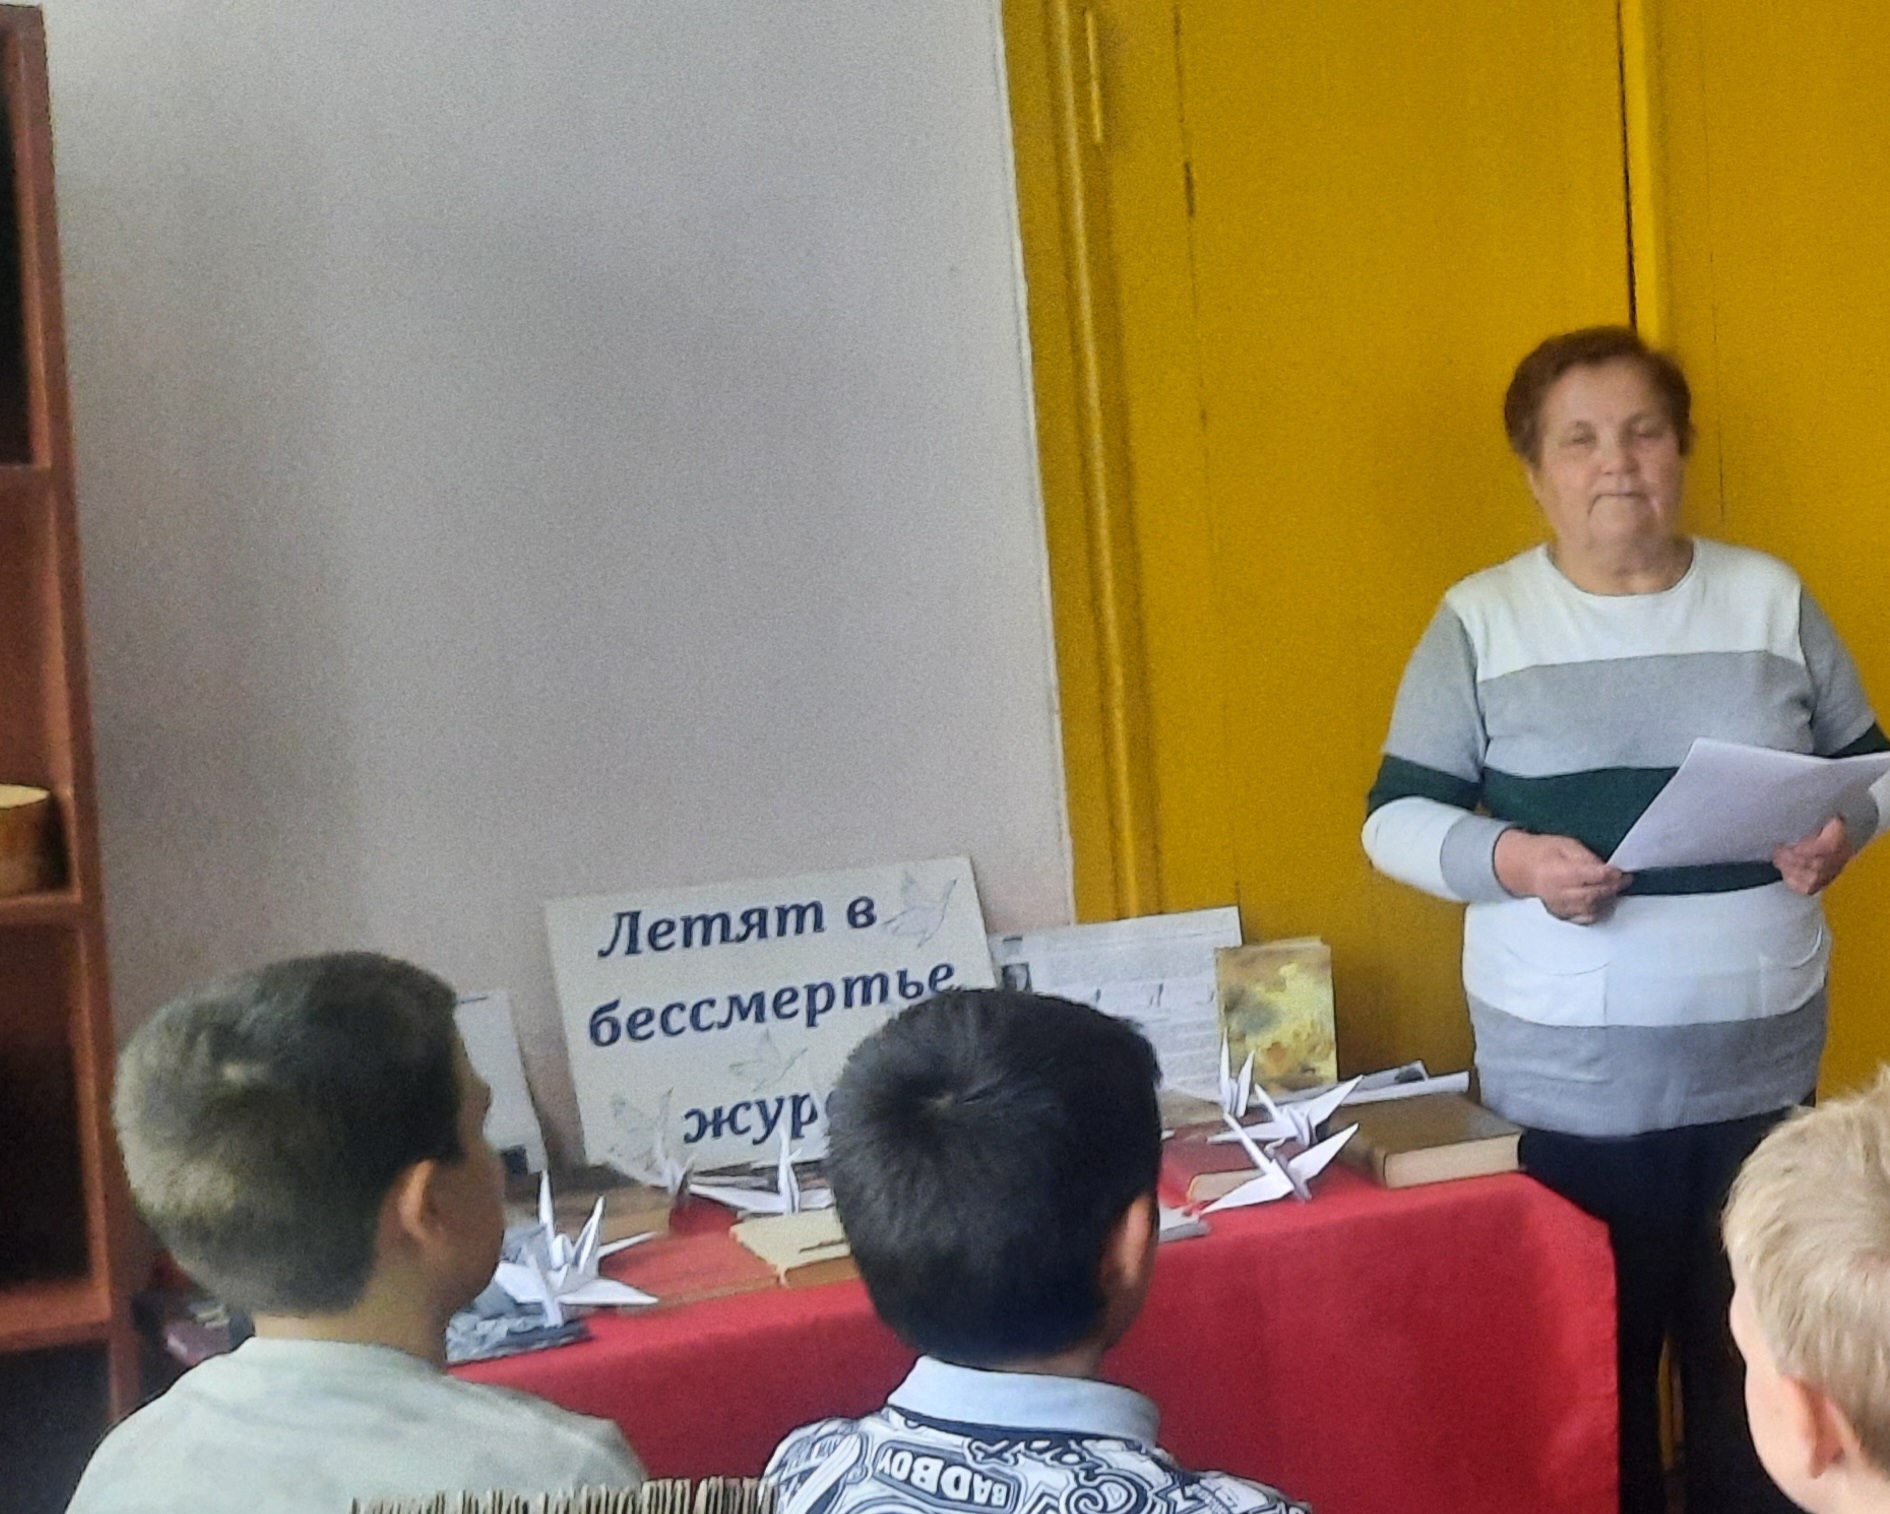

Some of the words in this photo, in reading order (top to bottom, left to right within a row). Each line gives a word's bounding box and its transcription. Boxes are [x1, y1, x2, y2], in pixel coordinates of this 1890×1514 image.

[598, 900, 825, 959] Летят
[845, 896, 877, 930] в
[588, 962, 957, 1048] бессмертье
[682, 1093, 834, 1146] жур
